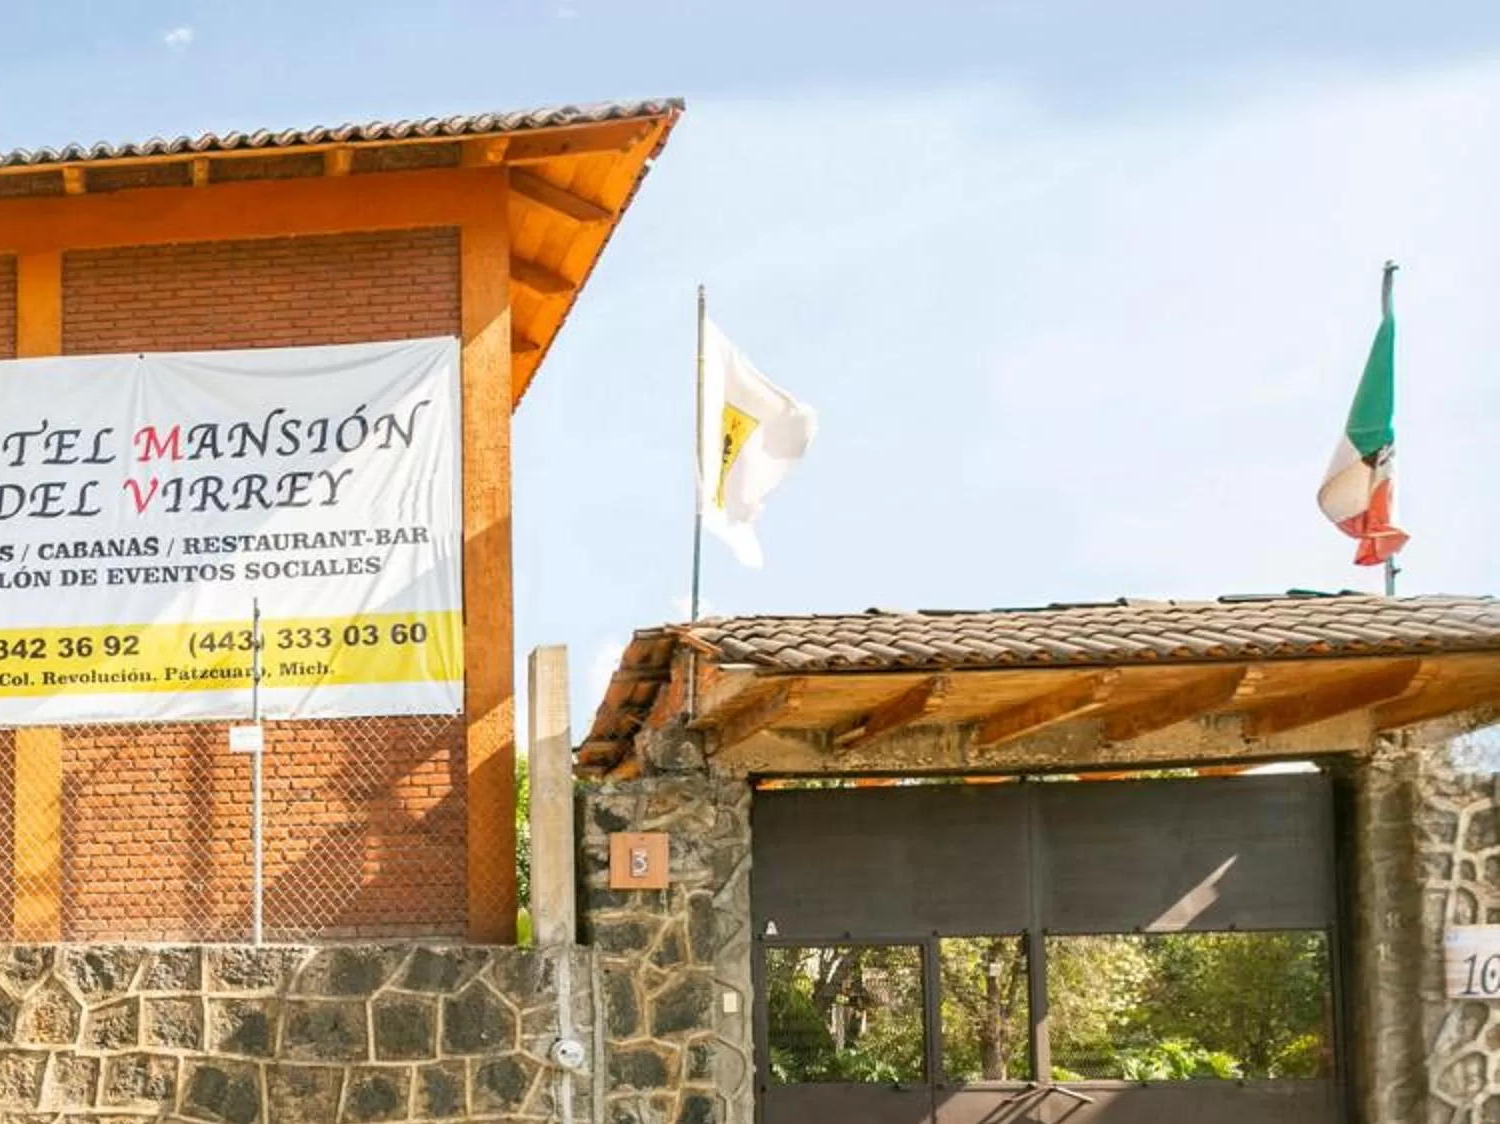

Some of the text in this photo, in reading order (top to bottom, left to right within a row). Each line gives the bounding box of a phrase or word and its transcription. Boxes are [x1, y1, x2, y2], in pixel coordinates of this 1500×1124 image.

[133, 400, 431, 463] MANSIÓN
[123, 468, 353, 514] VIRREY
[37, 536, 159, 560] CABANAS
[183, 527, 429, 555] RESTAURANT-BAR
[60, 569, 98, 586] DE
[107, 563, 235, 585] EVENTOS
[244, 556, 382, 580] SOCIALES
[58, 636, 93, 658] 36
[103, 635, 140, 656] 92
[277, 627, 332, 649] 333
[343, 624, 379, 646] 03
[390, 623, 427, 645] 60
